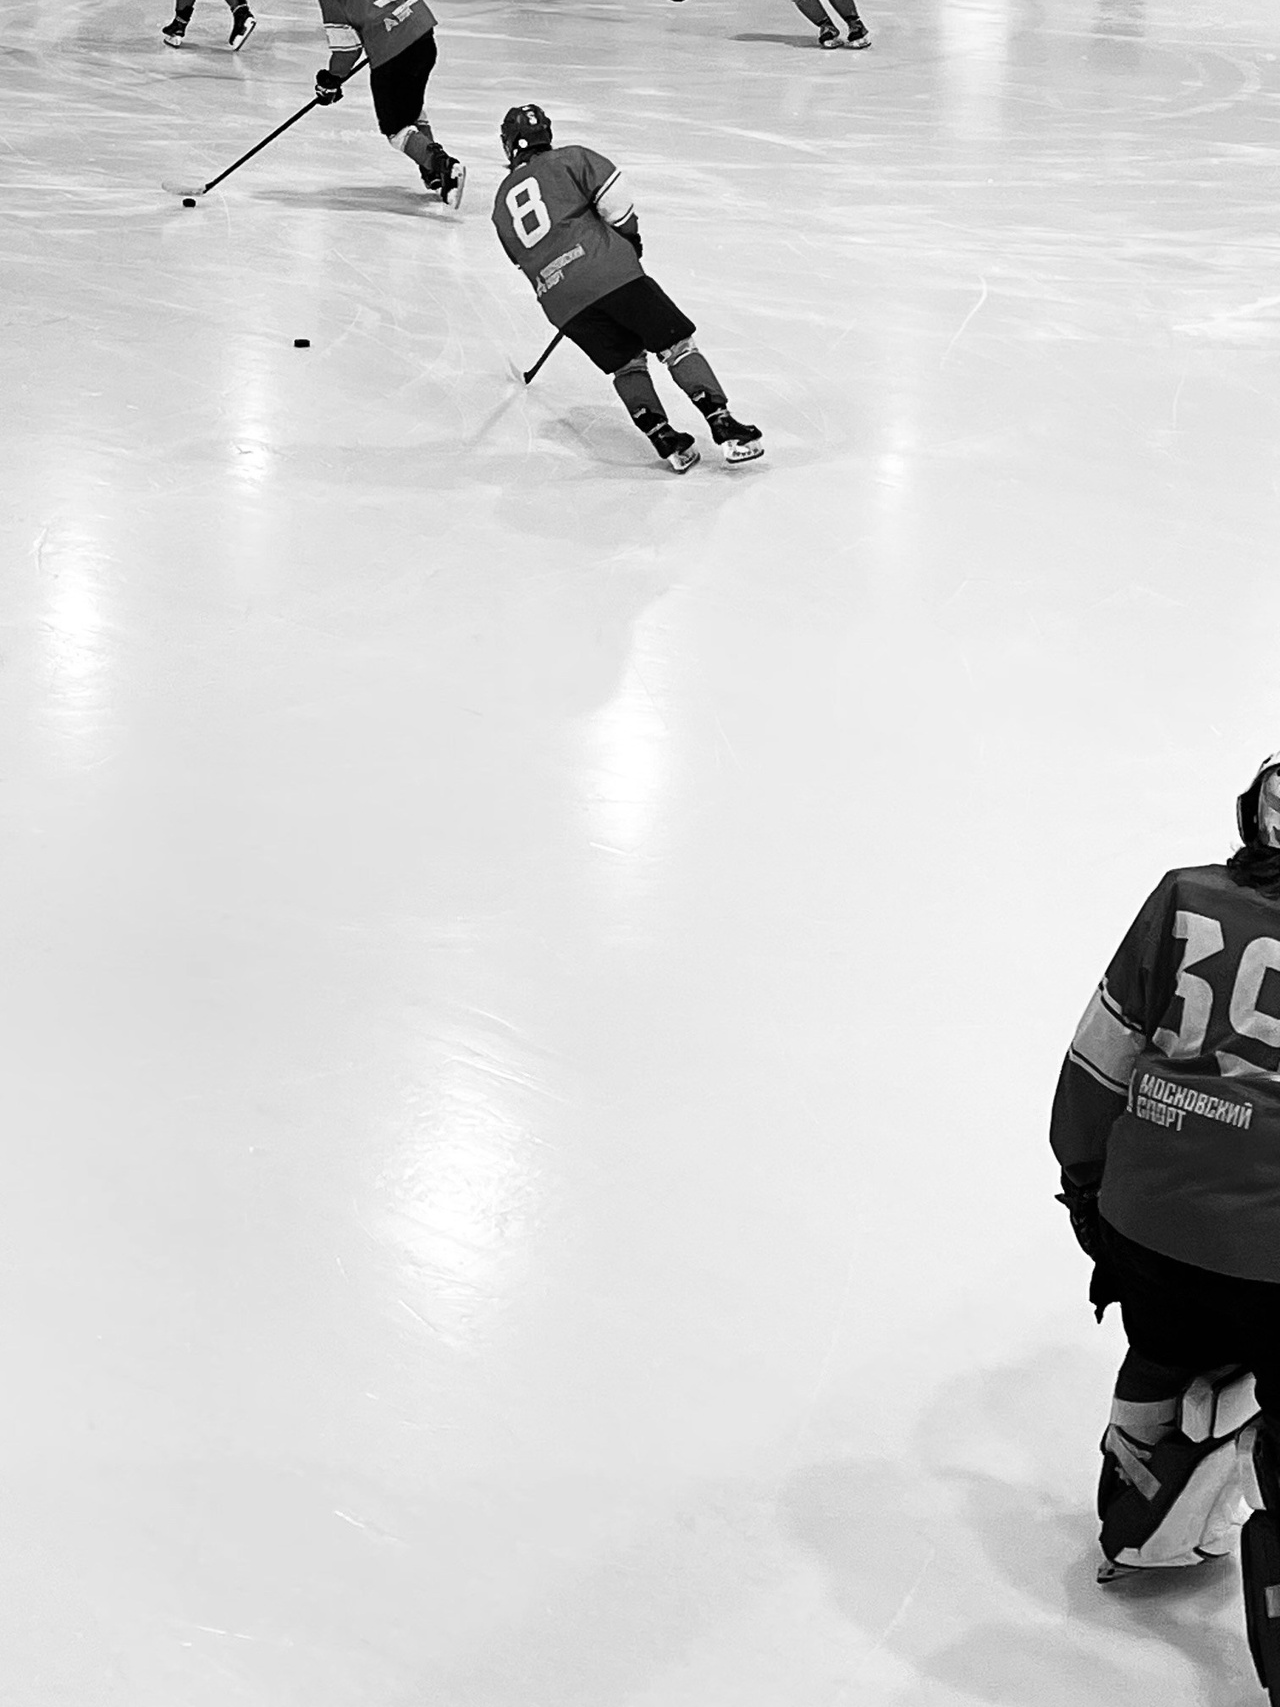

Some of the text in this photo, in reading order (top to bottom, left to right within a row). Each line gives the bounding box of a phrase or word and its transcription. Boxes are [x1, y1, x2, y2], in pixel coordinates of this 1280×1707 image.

[505, 176, 551, 249] 8
[1136, 1095, 1187, 1132] СПОРТ
[1138, 1073, 1253, 1130] МОСКОВСКИЙ
